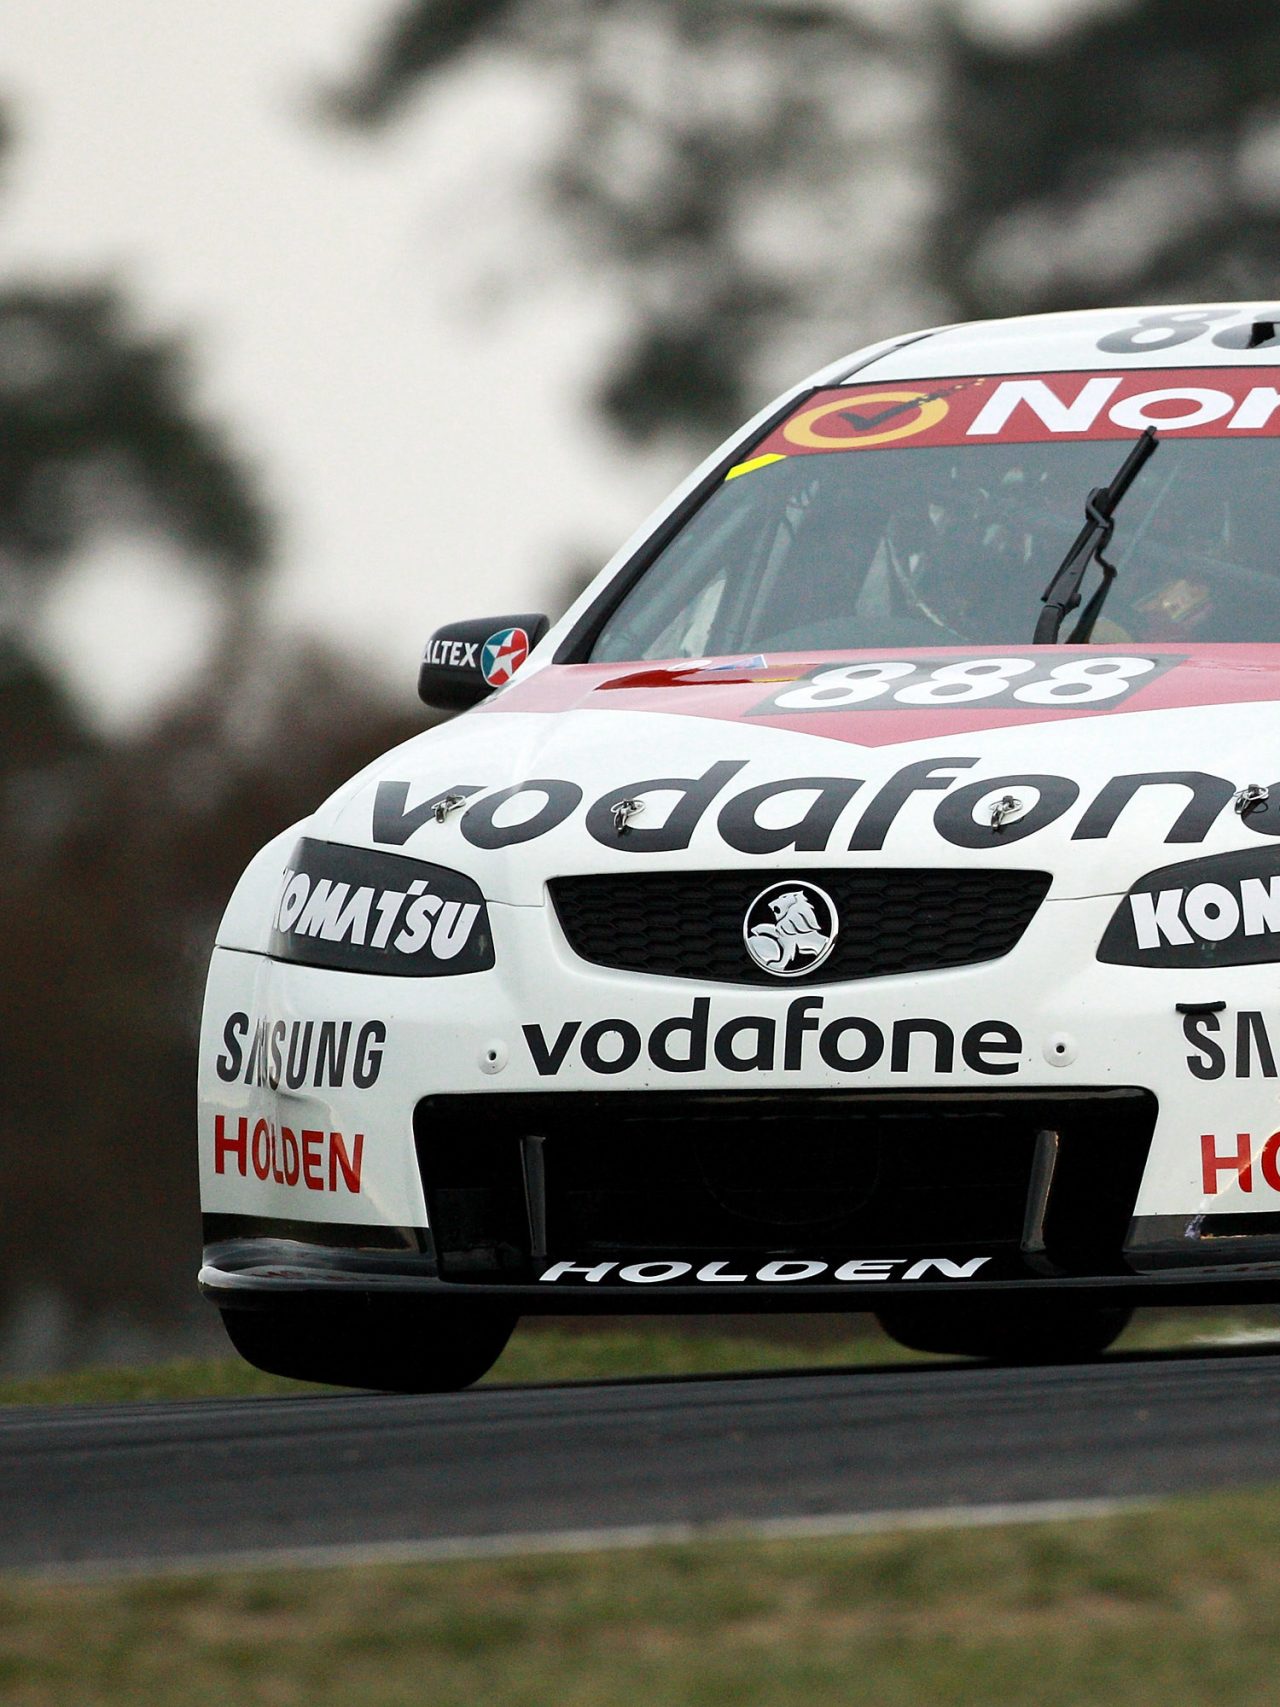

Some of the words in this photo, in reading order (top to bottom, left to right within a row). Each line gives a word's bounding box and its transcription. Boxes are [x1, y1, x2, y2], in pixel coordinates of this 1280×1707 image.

[422, 640, 478, 668] ALTEX
[774, 657, 1156, 709] 888
[521, 996, 1022, 1075] vodafone
[214, 1115, 364, 1193] HOLDEN
[539, 1257, 992, 1282] HOLDEN
